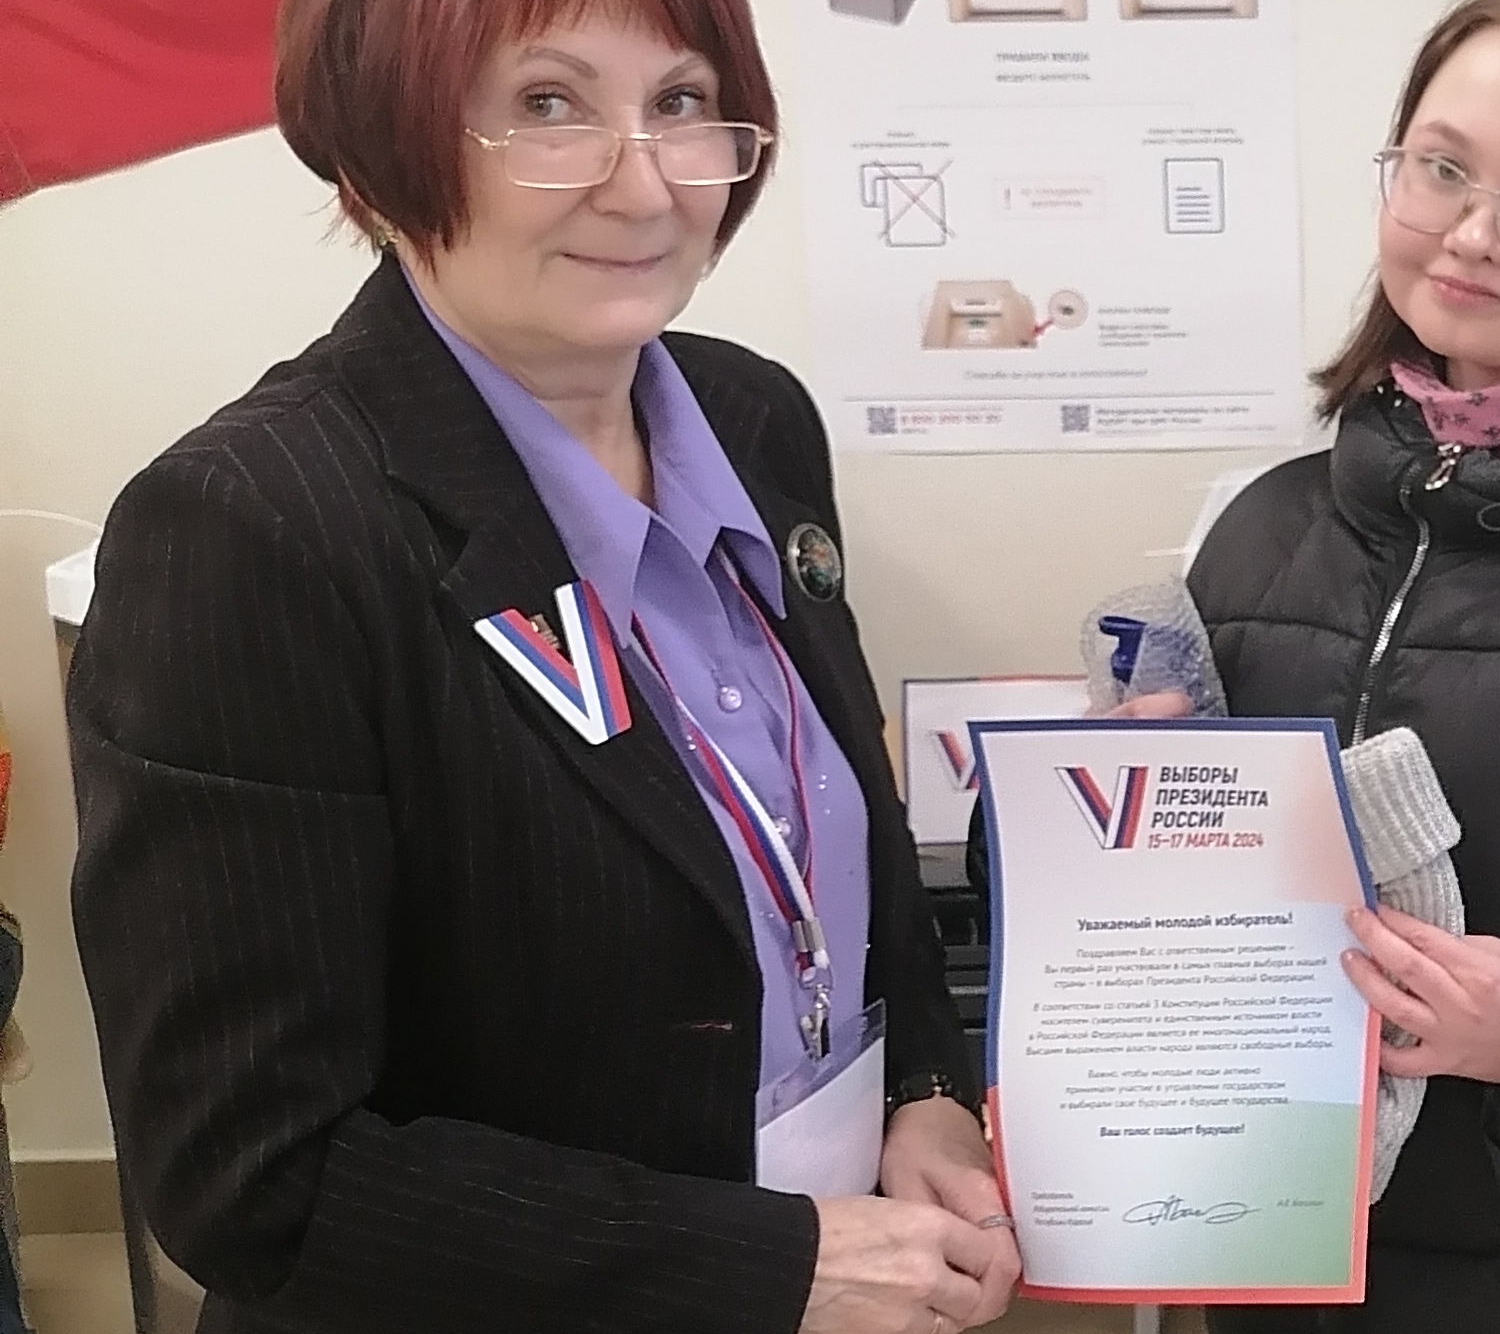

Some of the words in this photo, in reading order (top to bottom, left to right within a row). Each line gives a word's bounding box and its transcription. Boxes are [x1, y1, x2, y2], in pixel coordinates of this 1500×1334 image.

[1159, 767, 1238, 784] ВЫБОРЫ
[1155, 789, 1269, 808] ПРЕЗИДЕНТА
[1151, 811, 1224, 828] РОССИИ
[1186, 833, 1230, 848] МАРТА
[1232, 833, 1264, 848] 2024
[1077, 917, 1152, 932] Уважаемый
[1155, 915, 1212, 928] молодой
[1215, 912, 1293, 929] избиратель!
[1099, 1126, 1122, 1137] Ваш
[1123, 1126, 1152, 1136] голос
[1195, 1123, 1246, 1136] будущее!
